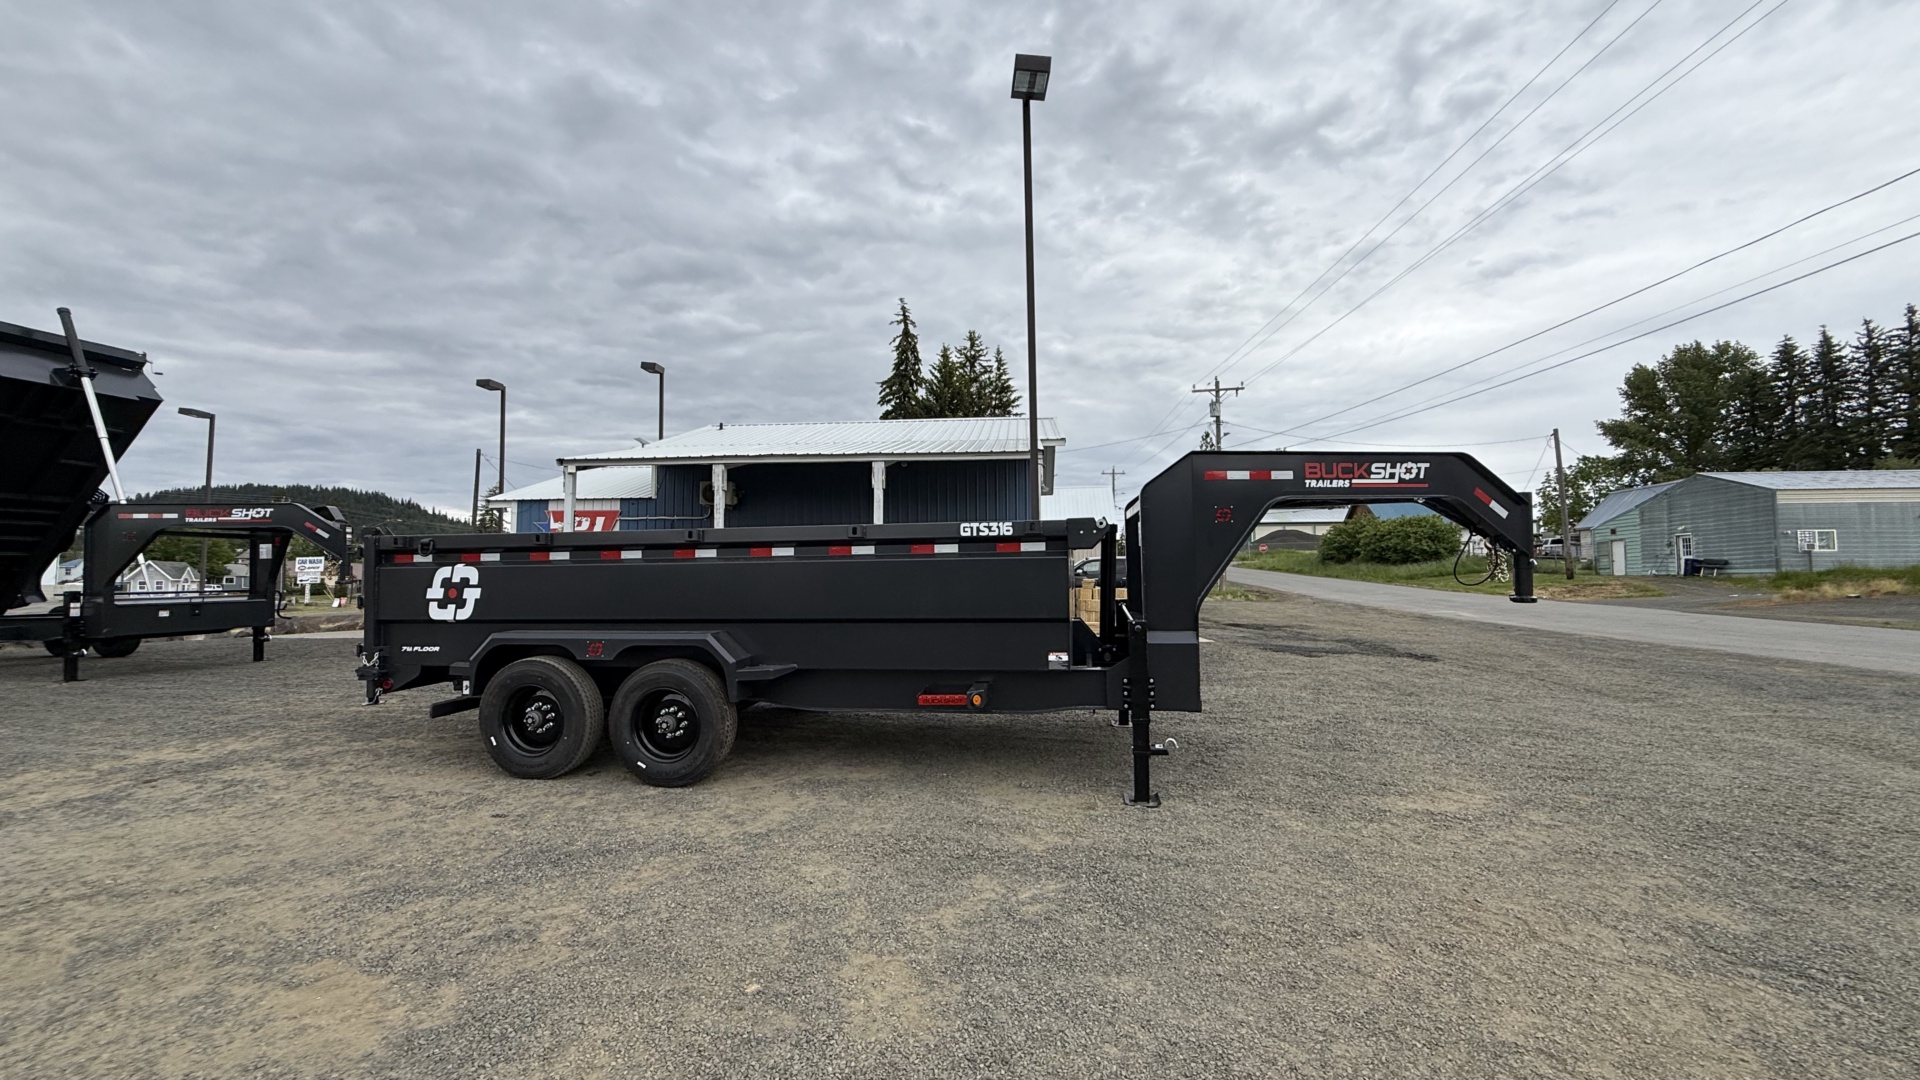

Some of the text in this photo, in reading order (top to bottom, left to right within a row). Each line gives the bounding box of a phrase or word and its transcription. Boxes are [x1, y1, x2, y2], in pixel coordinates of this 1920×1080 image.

[1304, 462, 1431, 480] BUCKSHOT
[1304, 479, 1351, 488] TRAILERS
[185, 508, 275, 518] BUCKSHOT
[960, 522, 1013, 536] GTS316
